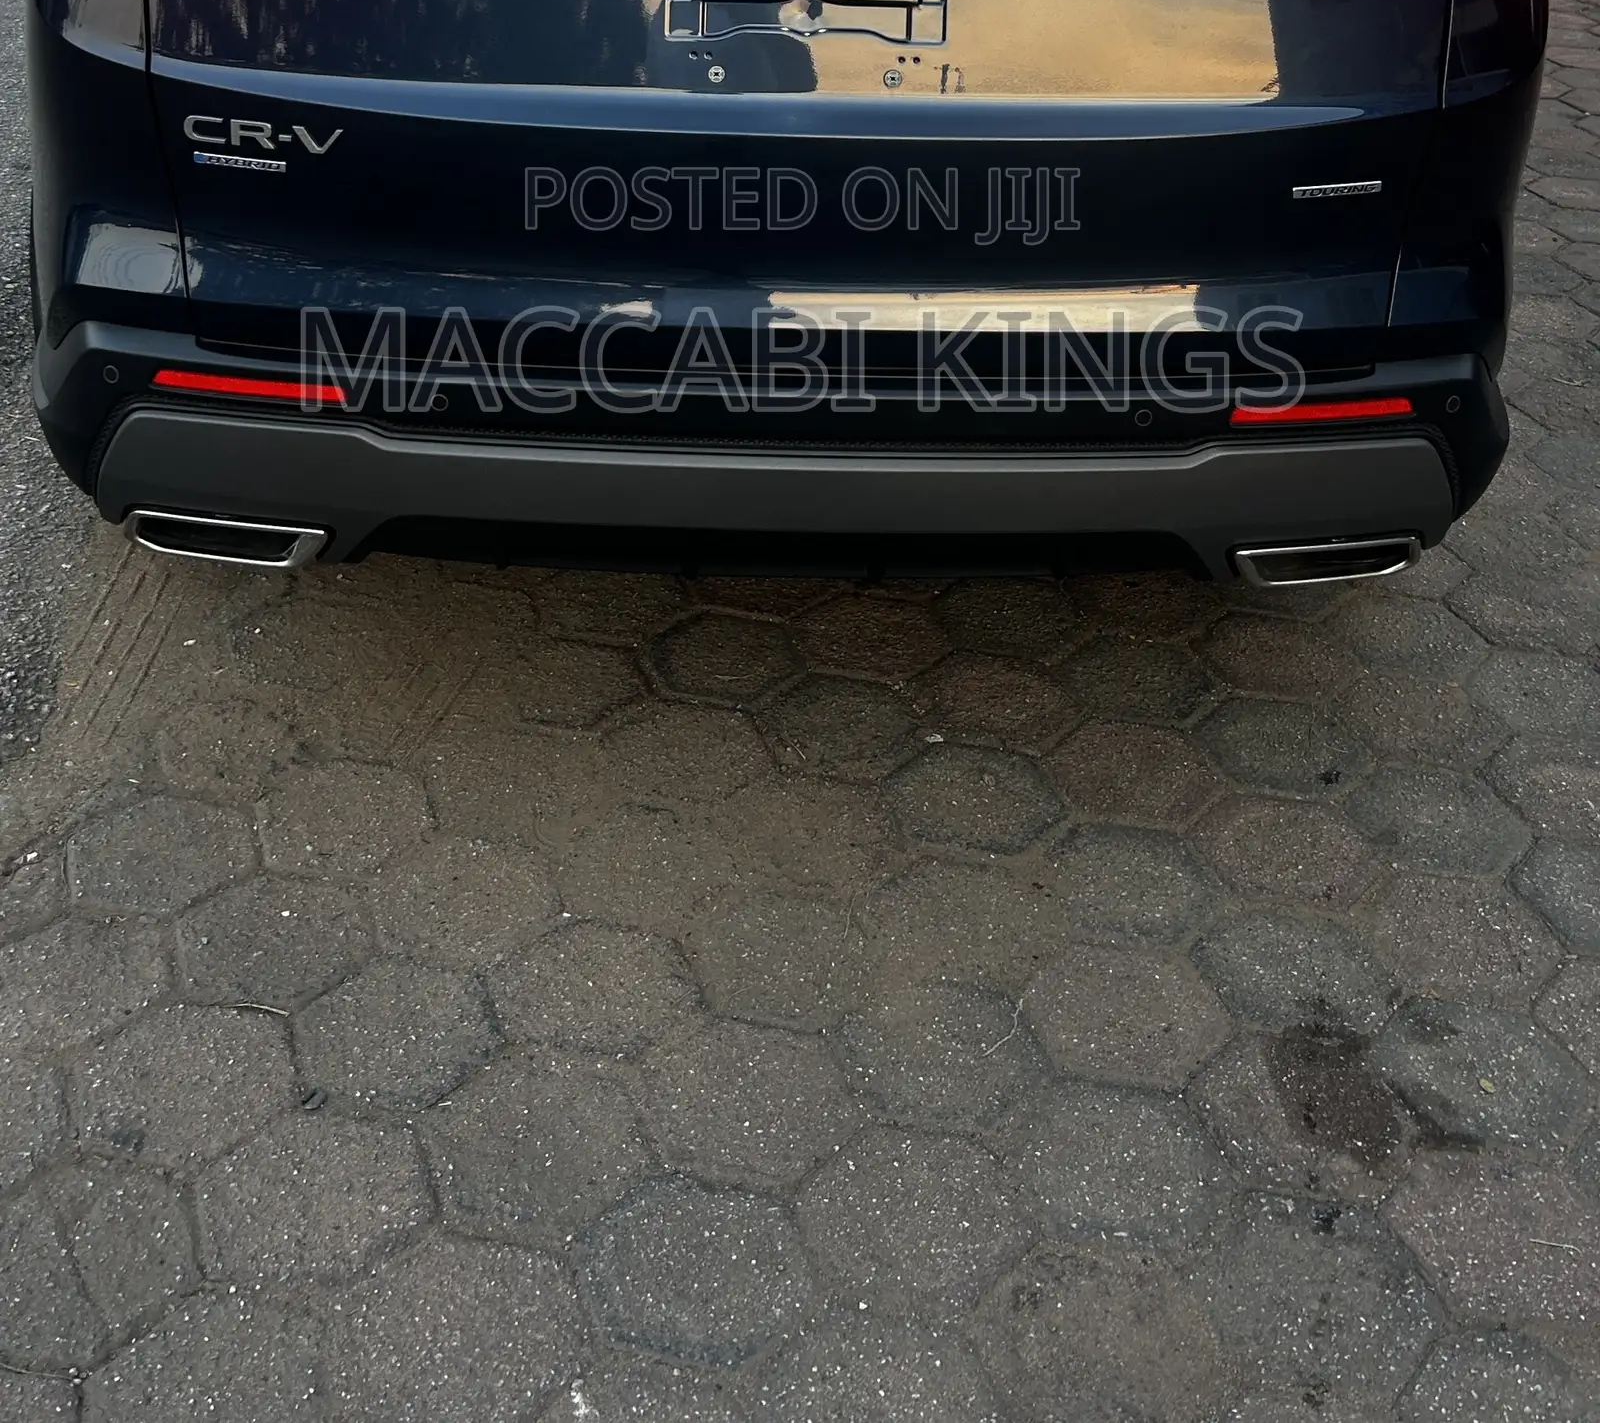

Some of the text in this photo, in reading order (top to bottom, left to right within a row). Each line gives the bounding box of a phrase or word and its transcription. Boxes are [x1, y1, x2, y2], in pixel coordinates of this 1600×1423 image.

[183, 114, 344, 155] CR-V
[206, 154, 283, 171] HYBRID
[1299, 184, 1378, 198] TOURING
